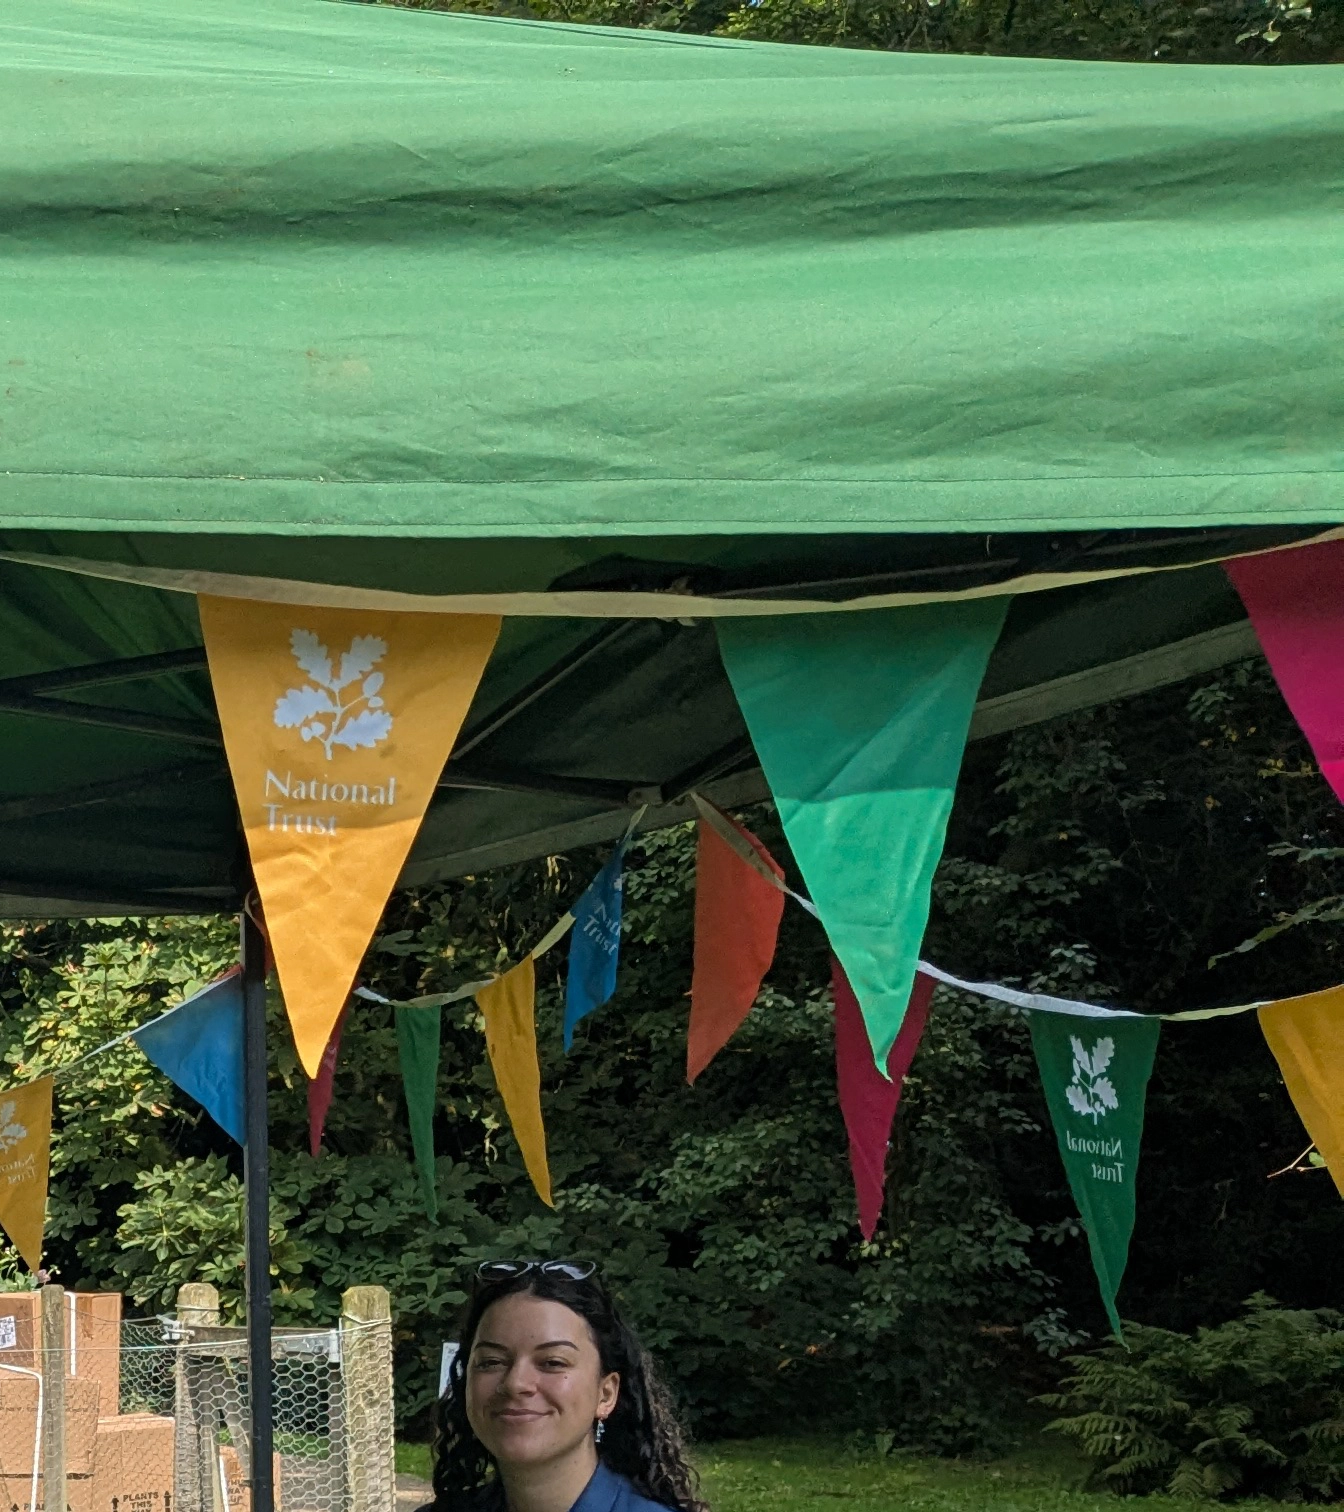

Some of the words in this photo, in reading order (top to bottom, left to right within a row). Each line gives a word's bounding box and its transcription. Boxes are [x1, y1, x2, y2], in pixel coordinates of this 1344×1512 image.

[265, 769, 397, 805] National
[262, 803, 337, 836] Trust
[583, 914, 618, 956] Trust
[123, 1492, 159, 1503] PLANTS
[131, 1501, 153, 1510] THIS
